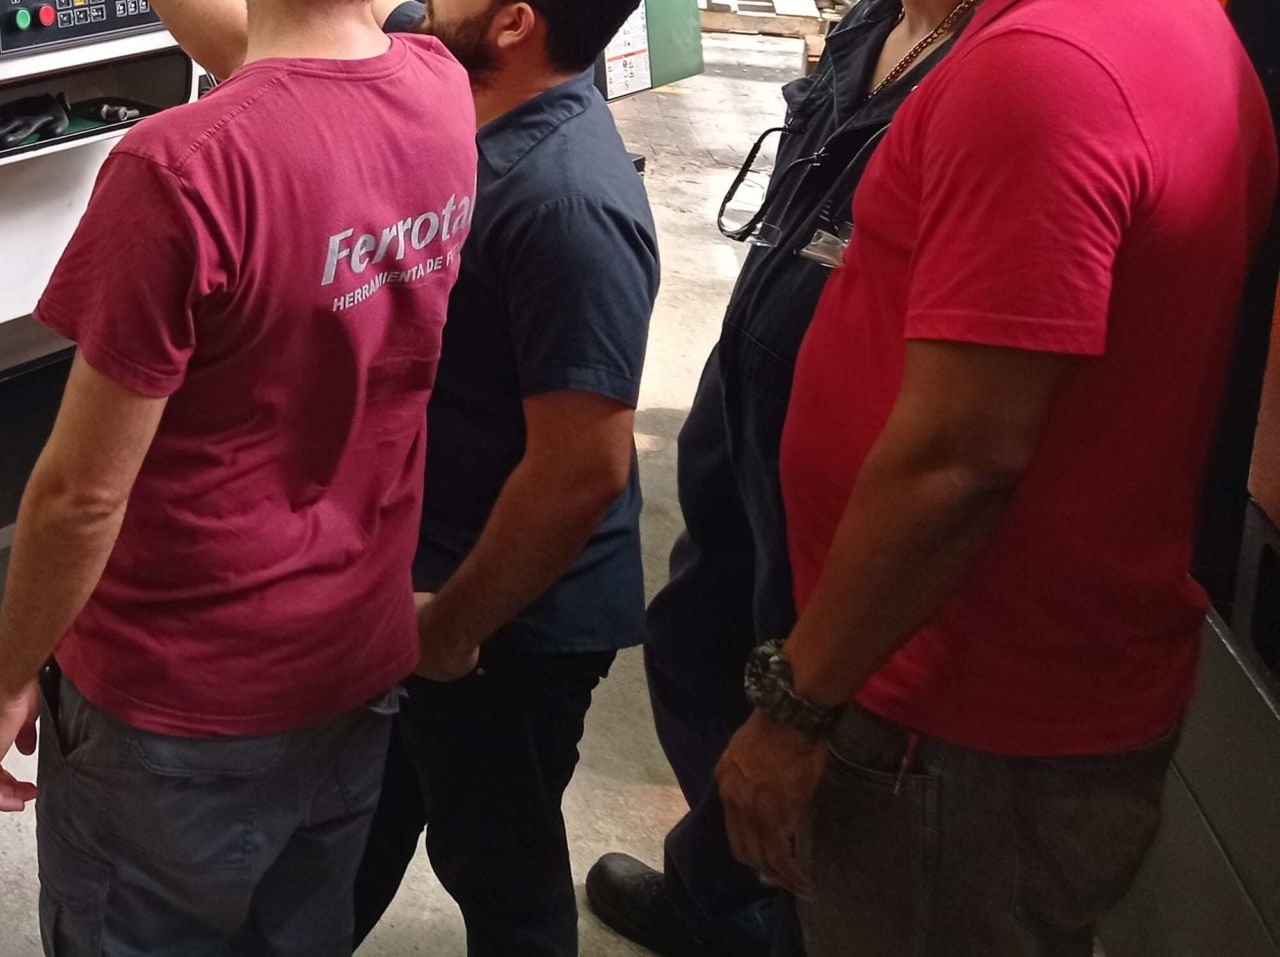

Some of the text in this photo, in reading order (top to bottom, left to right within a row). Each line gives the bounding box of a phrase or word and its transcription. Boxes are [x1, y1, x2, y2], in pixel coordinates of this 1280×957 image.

[321, 193, 476, 286] Ferrota
[332, 255, 443, 312] HERRAMIENTA DE
